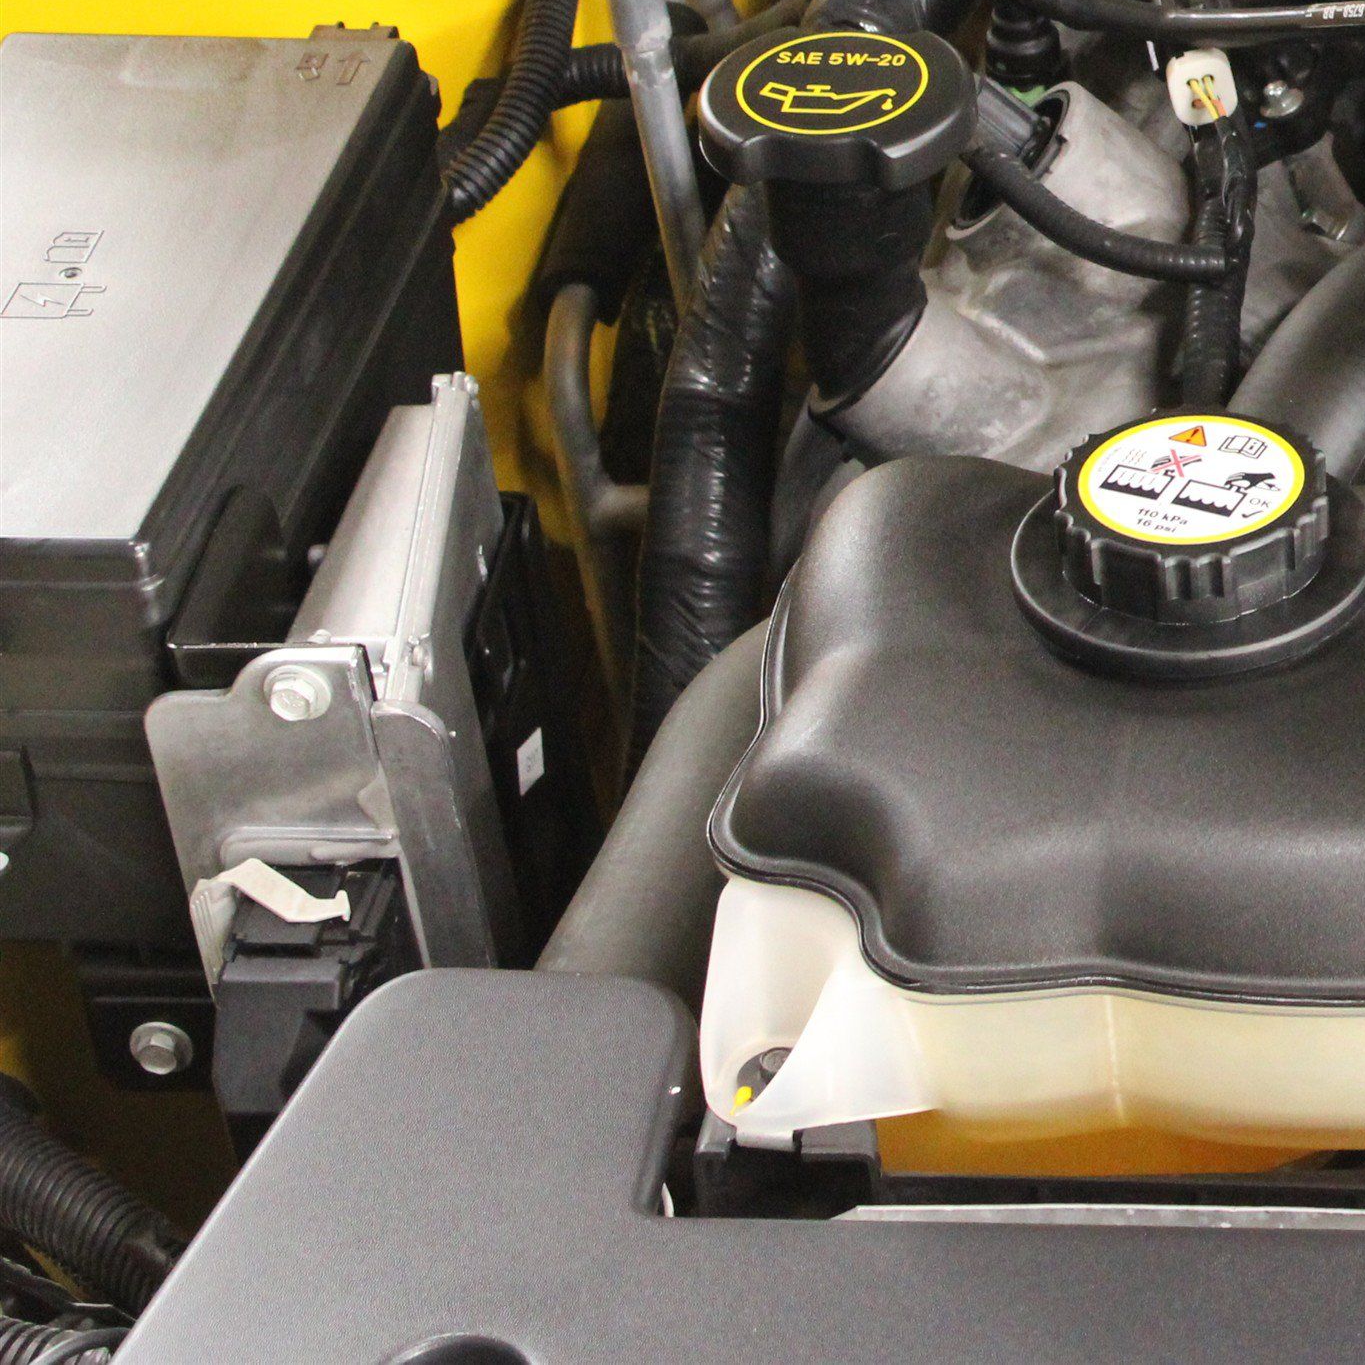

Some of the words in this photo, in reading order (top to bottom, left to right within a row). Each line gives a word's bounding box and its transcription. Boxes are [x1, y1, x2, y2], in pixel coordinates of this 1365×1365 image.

[776, 51, 823, 66] SAE
[828, 52, 907, 67] 5W-20
[1249, 497, 1273, 509] OK
[1137, 507, 1158, 518] 110
[1162, 510, 1189, 526] kPa
[1136, 518, 1151, 528] 16
[1154, 521, 1177, 534] psi
